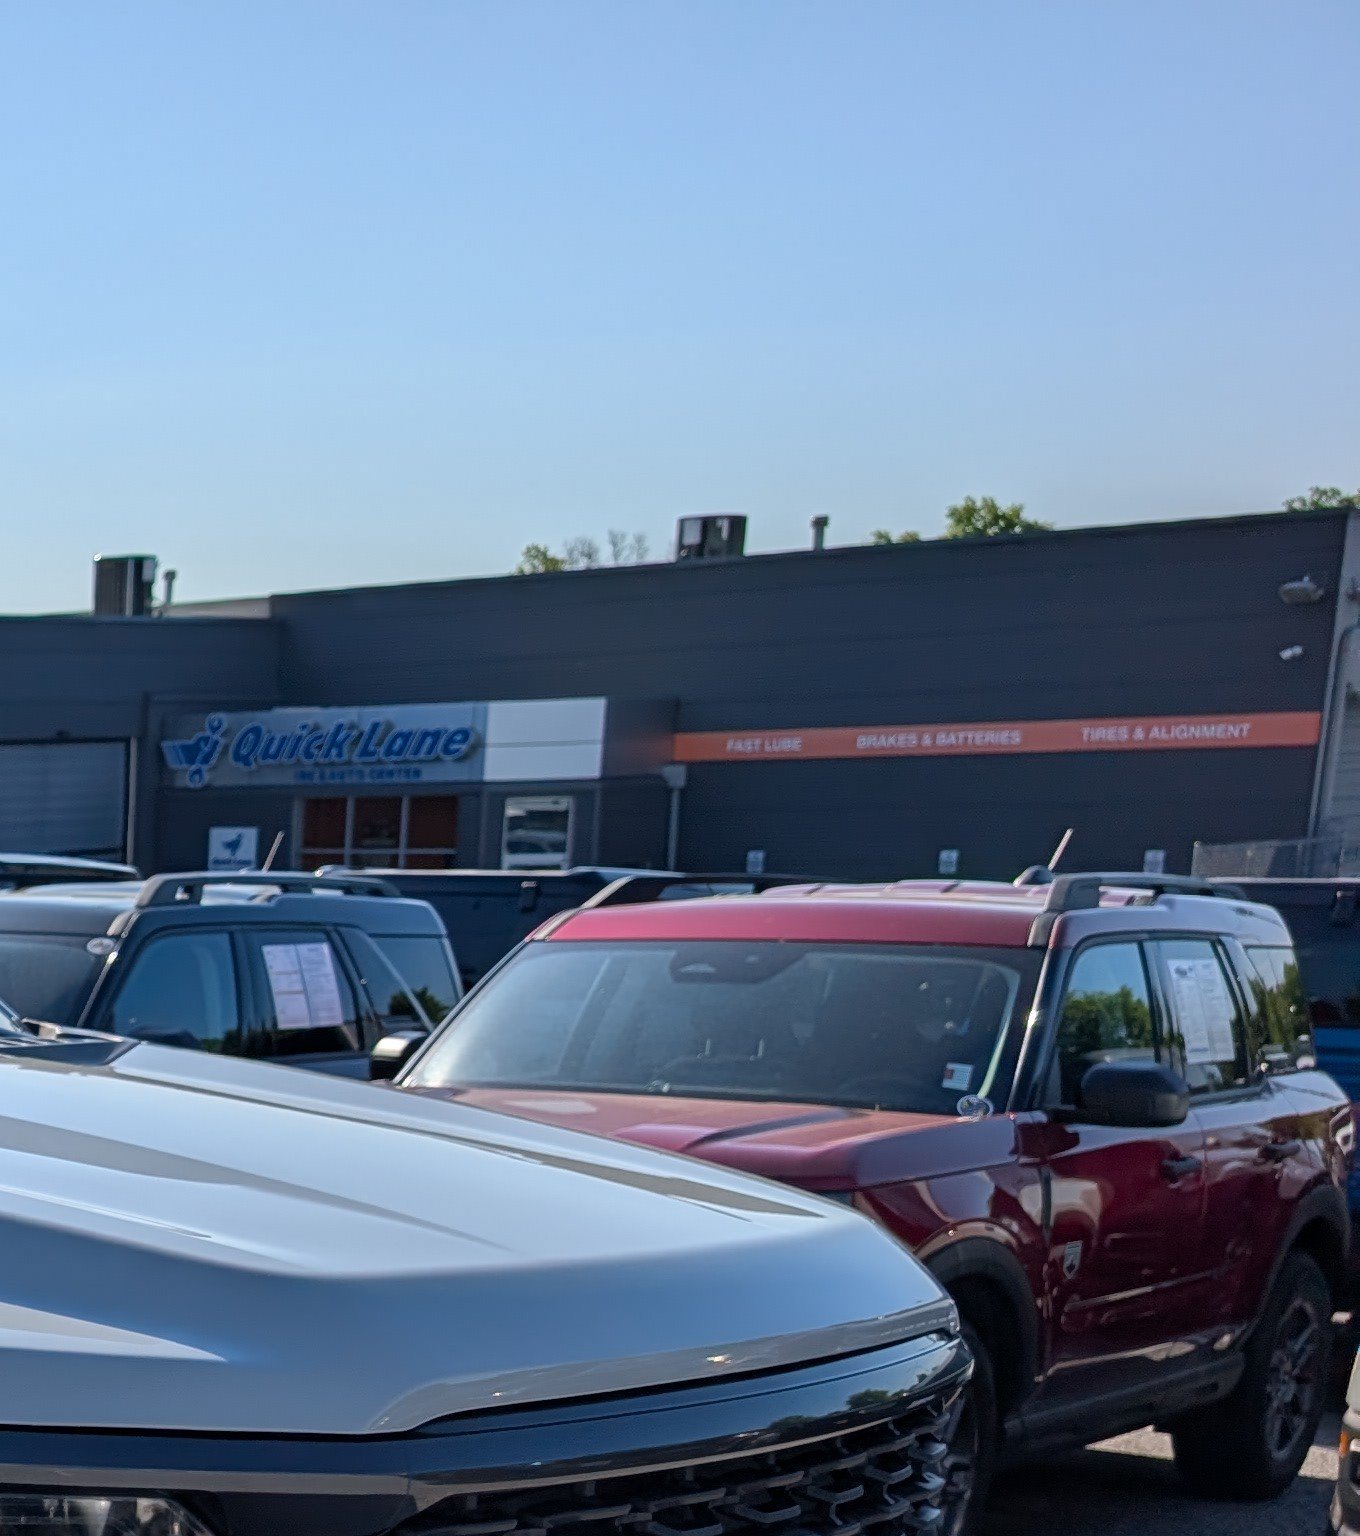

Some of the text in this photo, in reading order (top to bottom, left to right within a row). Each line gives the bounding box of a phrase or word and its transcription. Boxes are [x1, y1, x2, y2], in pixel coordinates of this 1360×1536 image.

[856, 734, 918, 748] BRAKES
[935, 729, 1022, 747] BATTERIES
[1148, 723, 1251, 740] ALIGNMENT
[231, 720, 473, 768] Quick Lane
